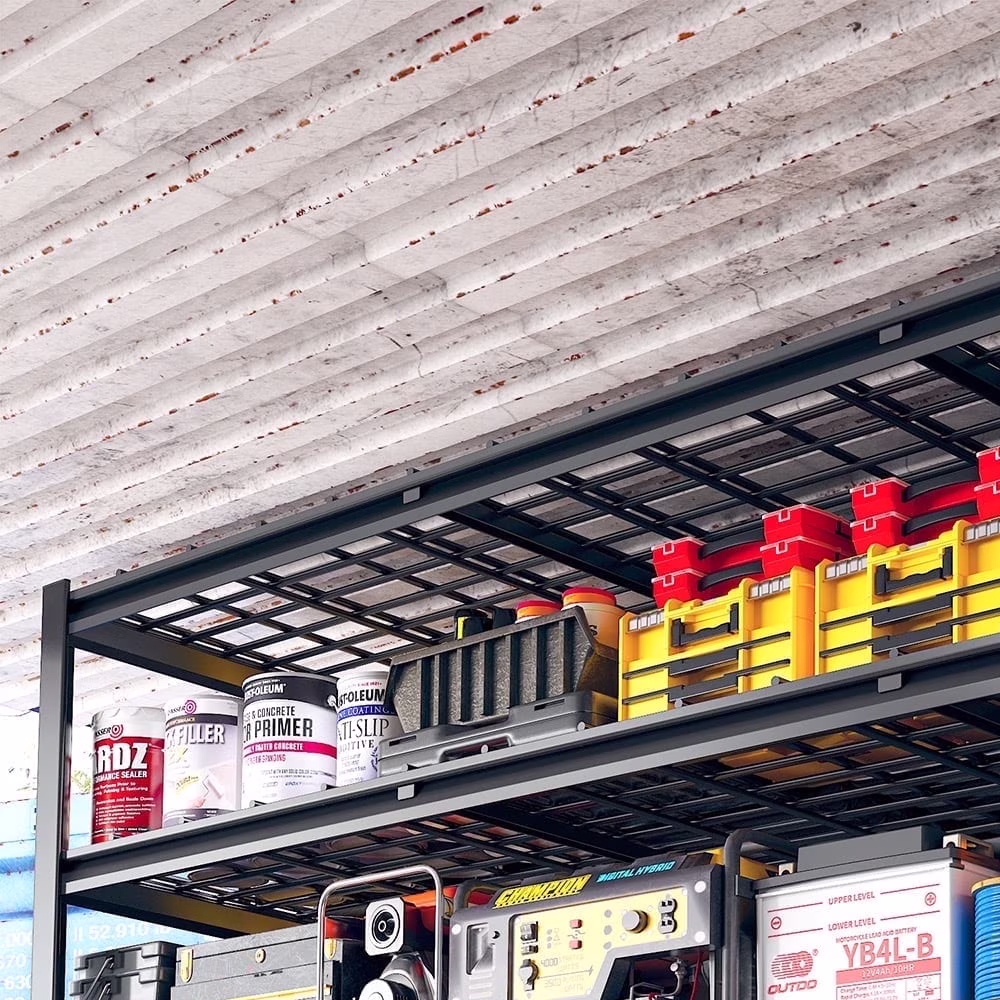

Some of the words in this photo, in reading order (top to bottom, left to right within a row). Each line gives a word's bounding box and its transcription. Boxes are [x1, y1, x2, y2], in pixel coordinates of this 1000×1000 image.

[257, 705, 296, 717] CONCRETE
[178, 723, 225, 745] FILLER
[254, 718, 313, 738] PRIMER
[121, 770, 148, 779] SEALER
[493, 874, 593, 908] CHAMPION
[828, 893, 853, 905] UPPER
[853, 891, 876, 902] LEVEL
[828, 920, 854, 932] LOWER
[854, 917, 877, 928] LEVEL
[842, 932, 934, 968] YB4L-B
[767, 979, 818, 995] OUTDO
